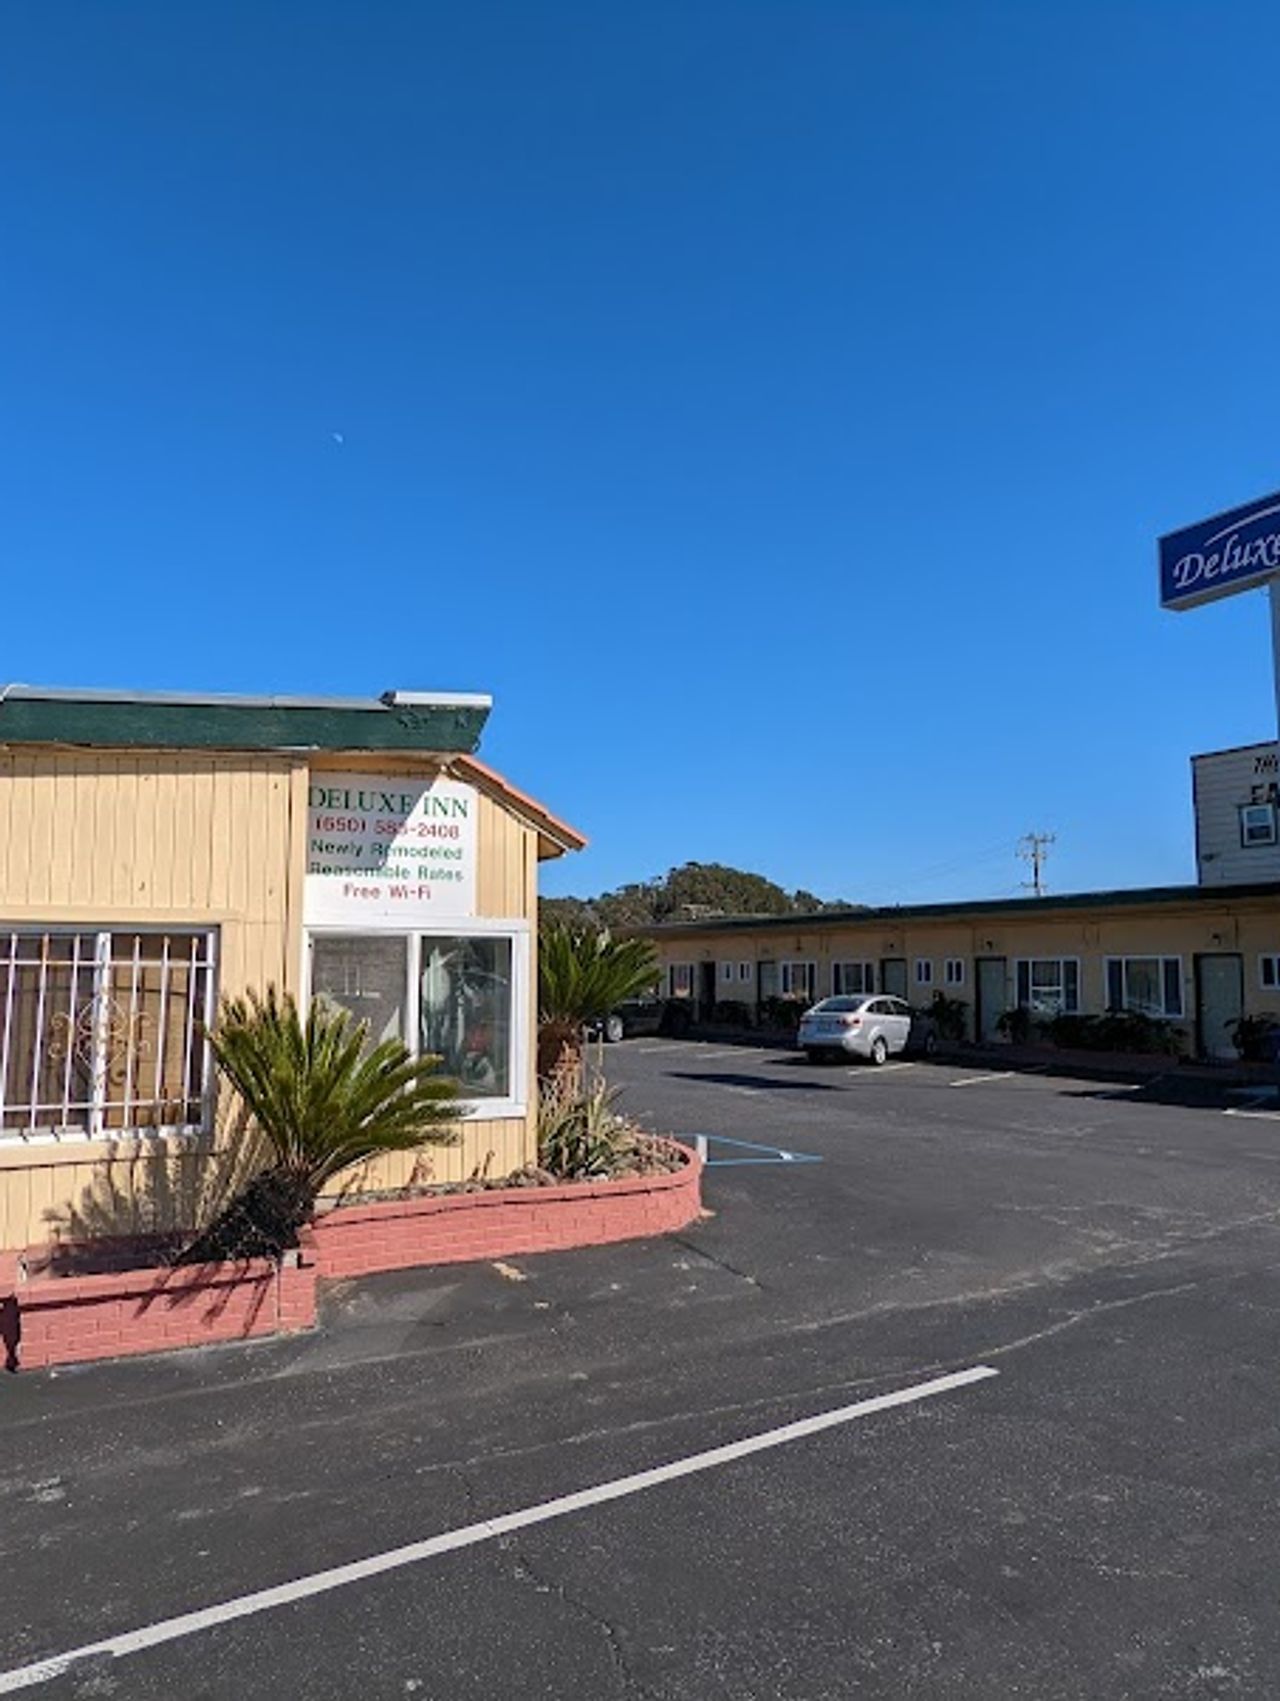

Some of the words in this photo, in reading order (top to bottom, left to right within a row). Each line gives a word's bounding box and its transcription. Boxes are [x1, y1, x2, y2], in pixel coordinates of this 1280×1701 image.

[1173, 534, 1280, 588] Deluxe
[309, 786, 415, 814] DELUXE
[423, 797, 469, 818] INN
[316, 816, 366, 833] (650)
[311, 839, 363, 857] Newly
[371, 842, 462, 860] Remodeled
[310, 862, 411, 879] Reasonable
[418, 865, 464, 882] Rates
[343, 884, 381, 898] Free
[389, 884, 431, 900] Wi-Fi
